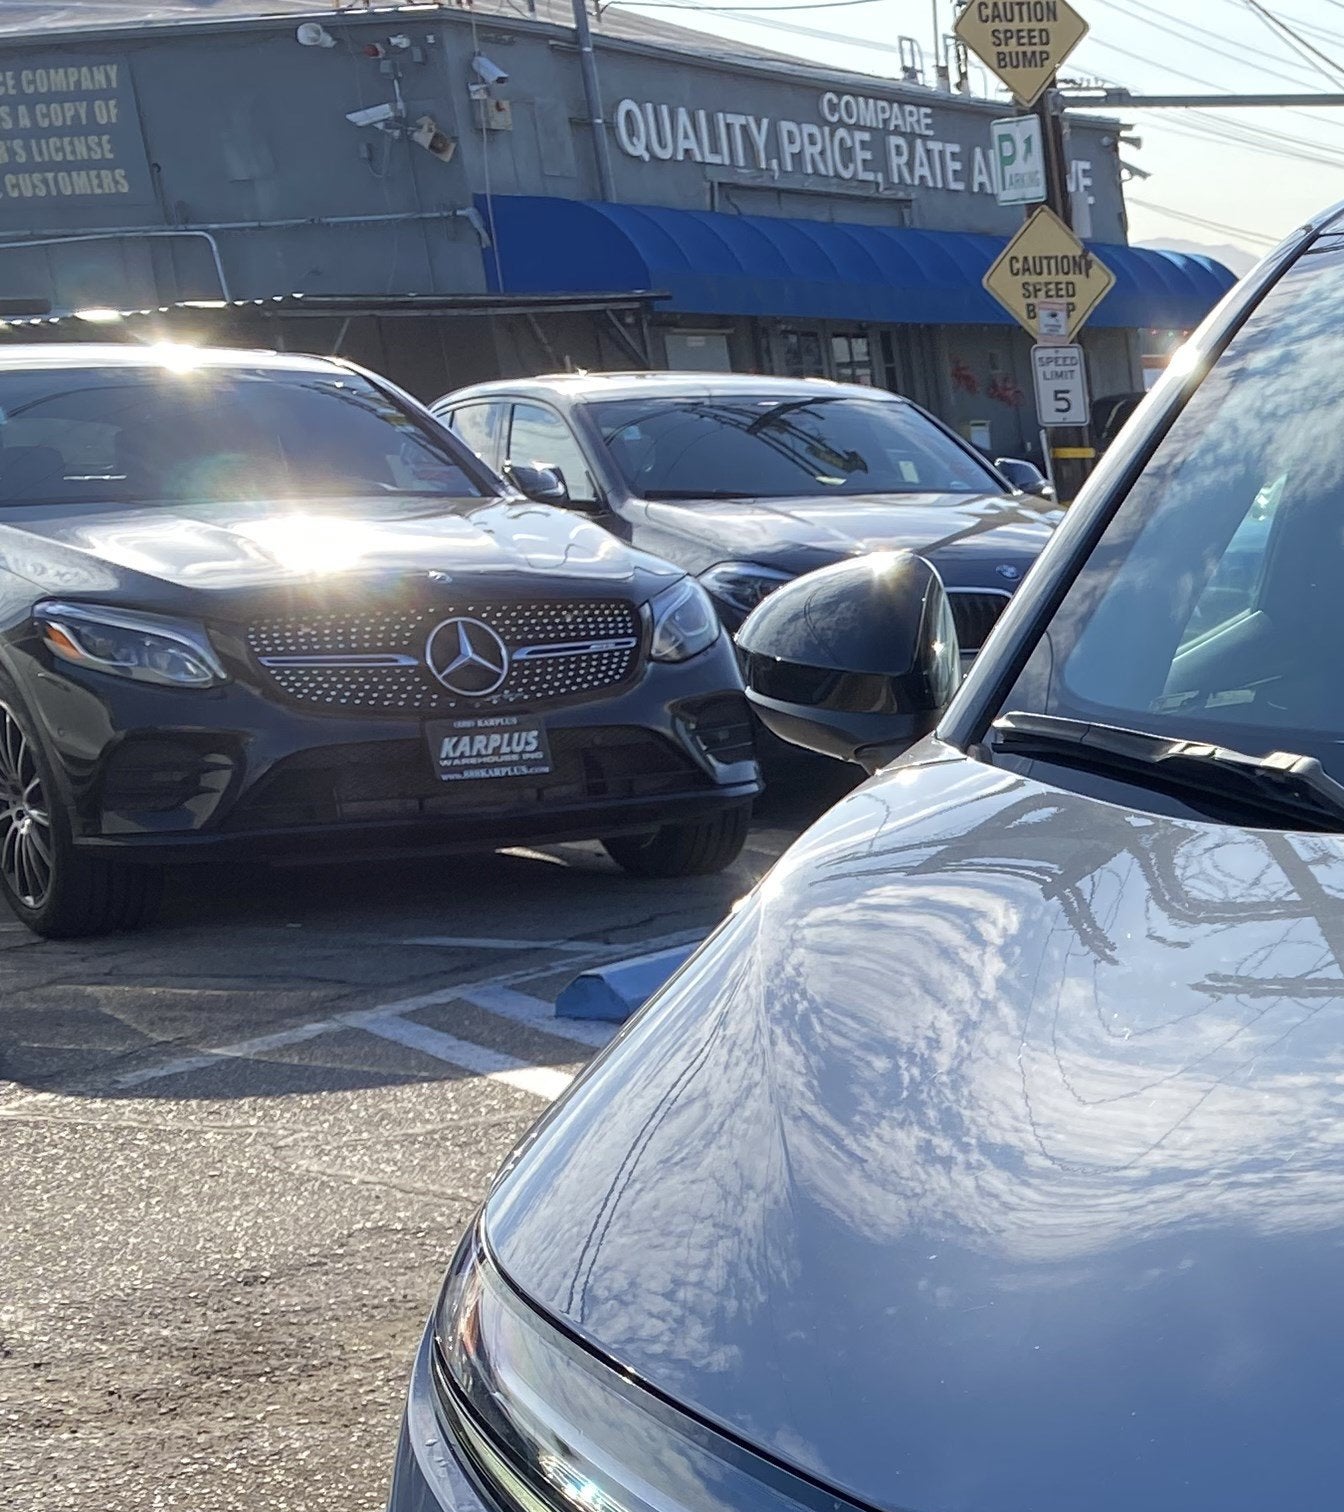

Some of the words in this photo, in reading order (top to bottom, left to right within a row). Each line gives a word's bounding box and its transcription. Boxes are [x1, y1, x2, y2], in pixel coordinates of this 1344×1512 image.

[977, 0, 1058, 23] CAUTION
[991, 28, 1051, 47] SPEED
[996, 50, 1050, 69] BUMP
[21, 64, 118, 94] COMPANY
[17, 104, 31, 129] A
[35, 101, 87, 128] COPY
[93, 98, 118, 125] OF
[821, 91, 934, 136] COMPARE
[30, 134, 114, 162] LICENSE
[887, 135, 966, 191] RATE
[4, 168, 129, 198] CUSTOMERS
[1009, 254, 1084, 277] CAUTION
[1022, 281, 1076, 299] SPEED
[1026, 302, 1076, 320] BP
[1038, 356, 1079, 367] SPEED
[1042, 370, 1076, 381] LIMIT
[1053, 389, 1072, 413] 5
[441, 730, 539, 759] KARPLUS
[439, 753, 520, 767] WAREHOUSE
